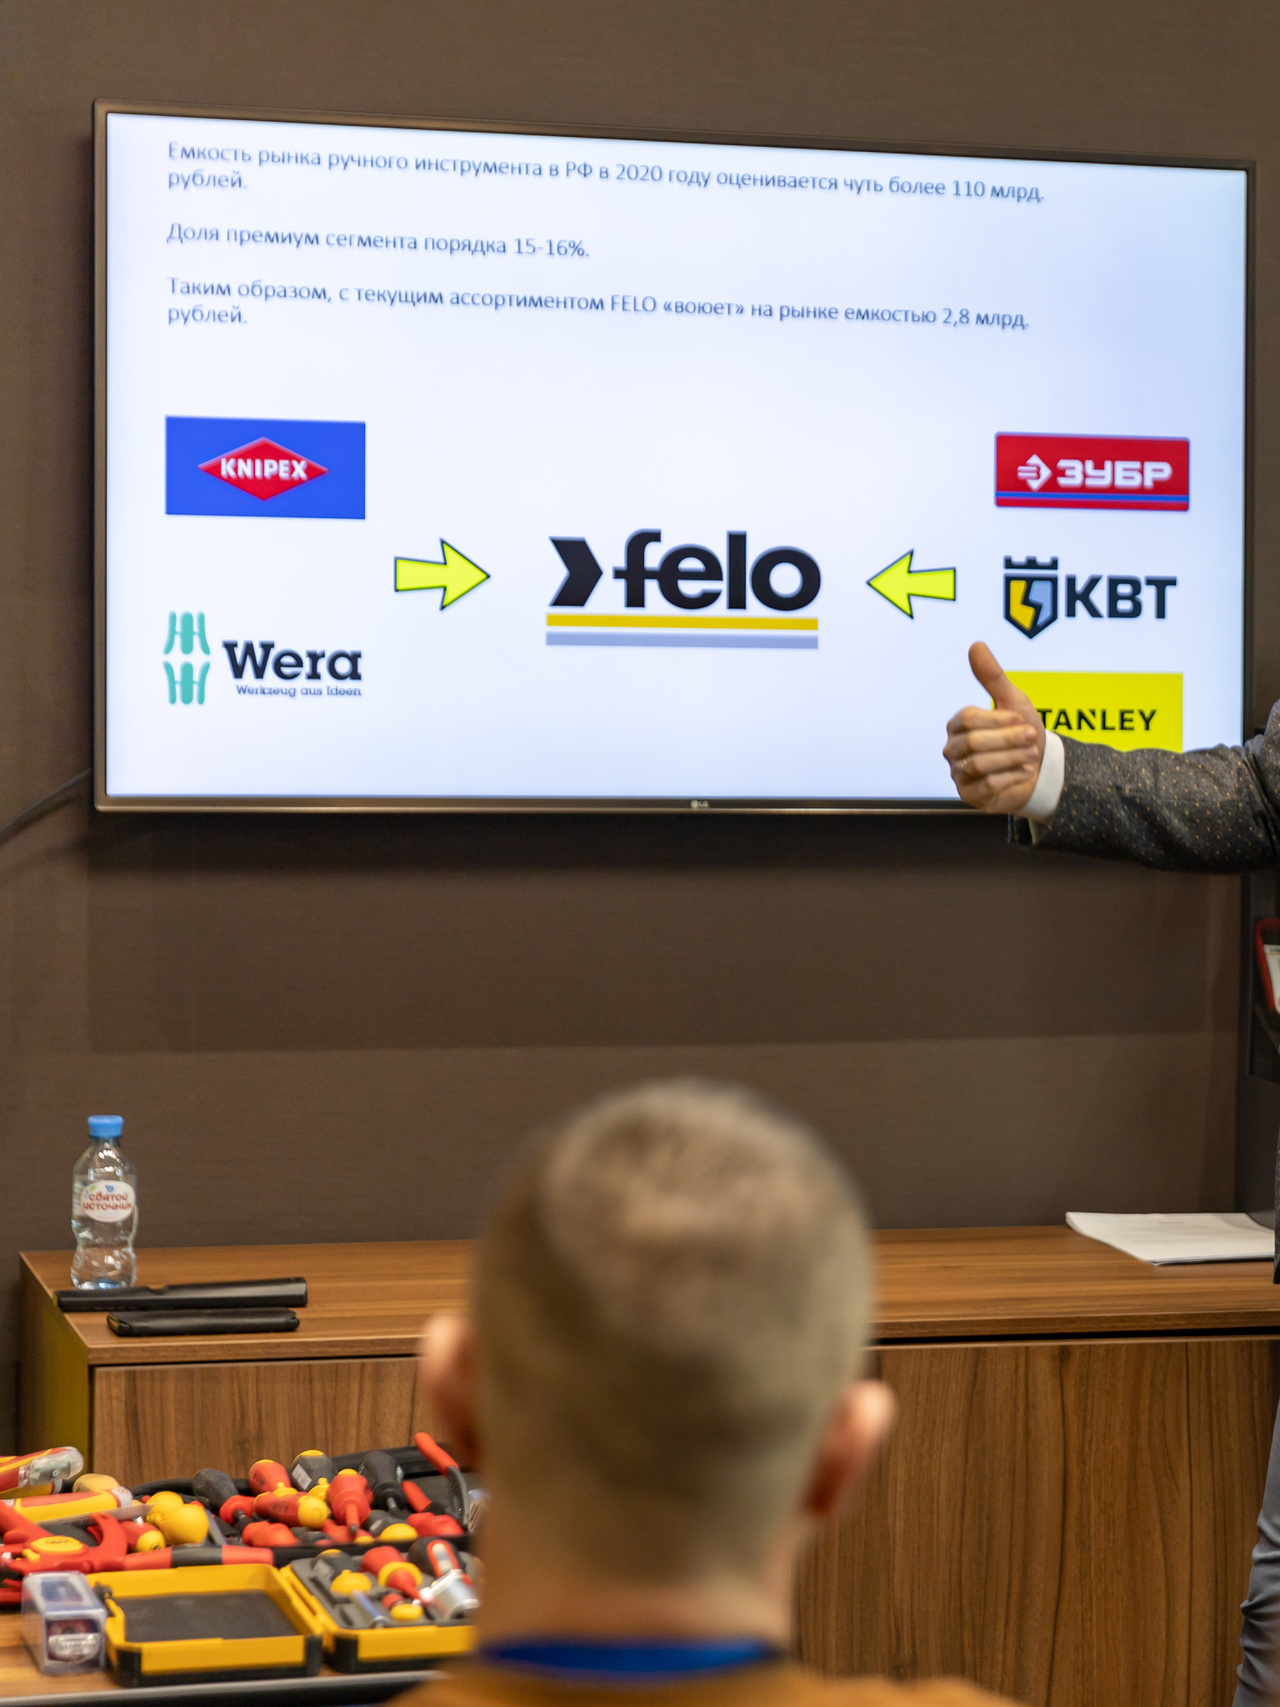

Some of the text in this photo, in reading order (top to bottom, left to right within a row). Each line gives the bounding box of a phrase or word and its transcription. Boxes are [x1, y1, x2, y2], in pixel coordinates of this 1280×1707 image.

[168, 141, 1045, 204] Емкость рынка ручного инструмента в РФ в 2020 году оценивается чуть более 110 млрд.
[168, 169, 248, 190] рублей.
[166, 222, 590, 257] Доля премиум сегмента порядка 15-16%.
[168, 277, 1030, 331] Таким образом, с текущим ассортиментом FELO «воюет» на рынке емкостью 2,8 млрд.
[168, 305, 248, 326] рублей.
[220, 457, 308, 480] KNIPEX
[1056, 458, 1173, 489] ЗУБР
[613, 528, 822, 611] felo
[222, 640, 362, 681] Wera
[235, 684, 362, 698] Werkzeug aus Ideen
[1036, 708, 1158, 731] TANLEY
